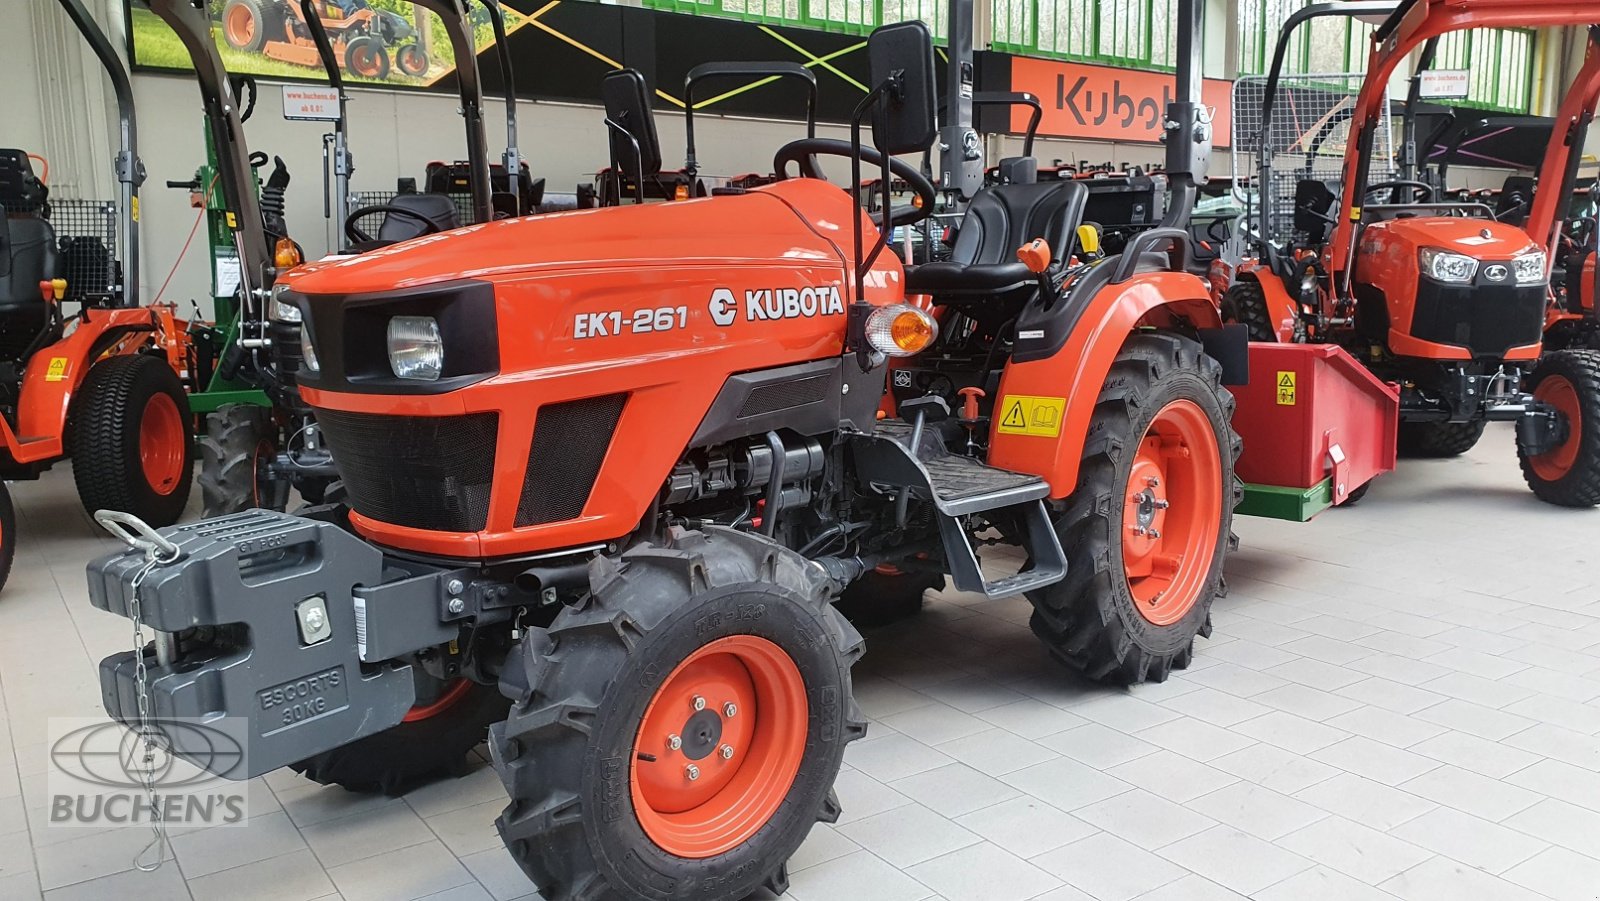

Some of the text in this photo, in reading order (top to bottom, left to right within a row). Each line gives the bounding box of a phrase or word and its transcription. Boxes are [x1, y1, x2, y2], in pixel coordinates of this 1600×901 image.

[286, 91, 337, 101] www.buchens.de
[745, 286, 844, 321] KUBOTA
[573, 306, 688, 339] EK1-261
[260, 670, 341, 710] ESCORTS
